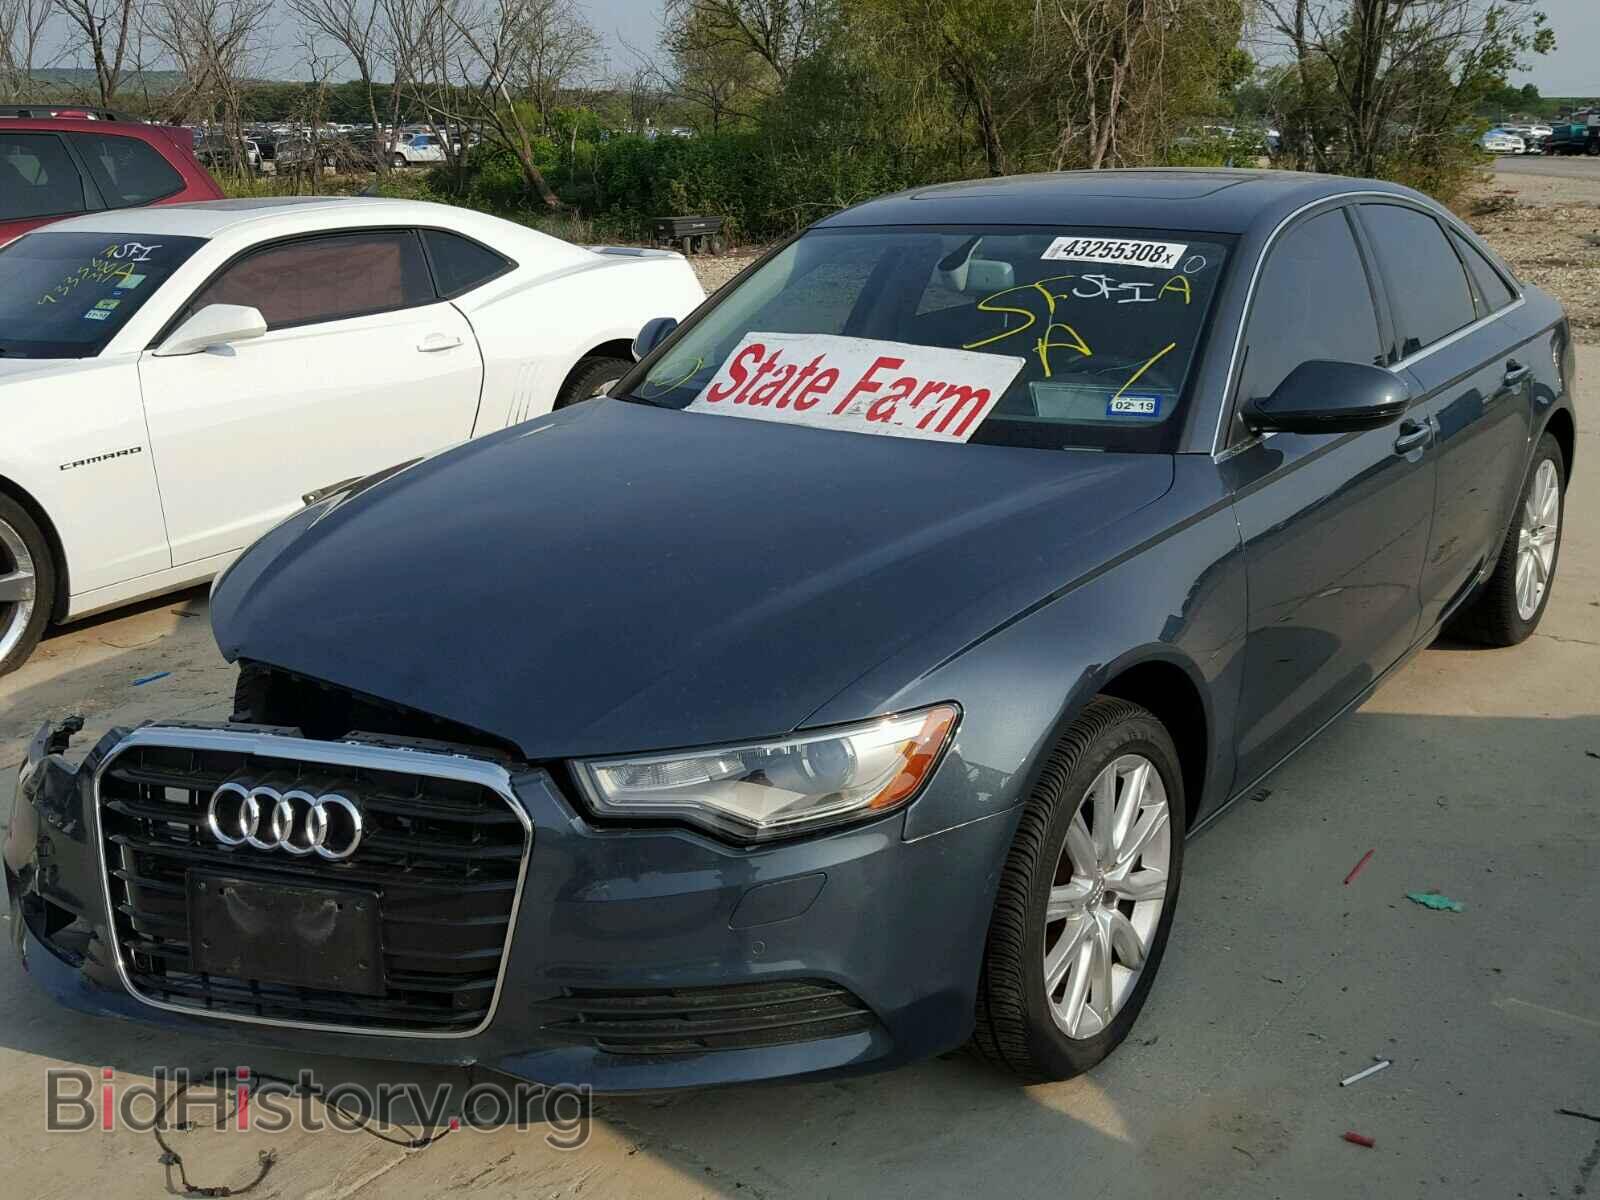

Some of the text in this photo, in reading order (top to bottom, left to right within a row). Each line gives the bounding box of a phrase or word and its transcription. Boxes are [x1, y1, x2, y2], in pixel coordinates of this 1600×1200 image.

[706, 343, 991, 437] State Farm
[1115, 401, 1154, 411] 02 19
[60, 446, 142, 471] CAMARO
